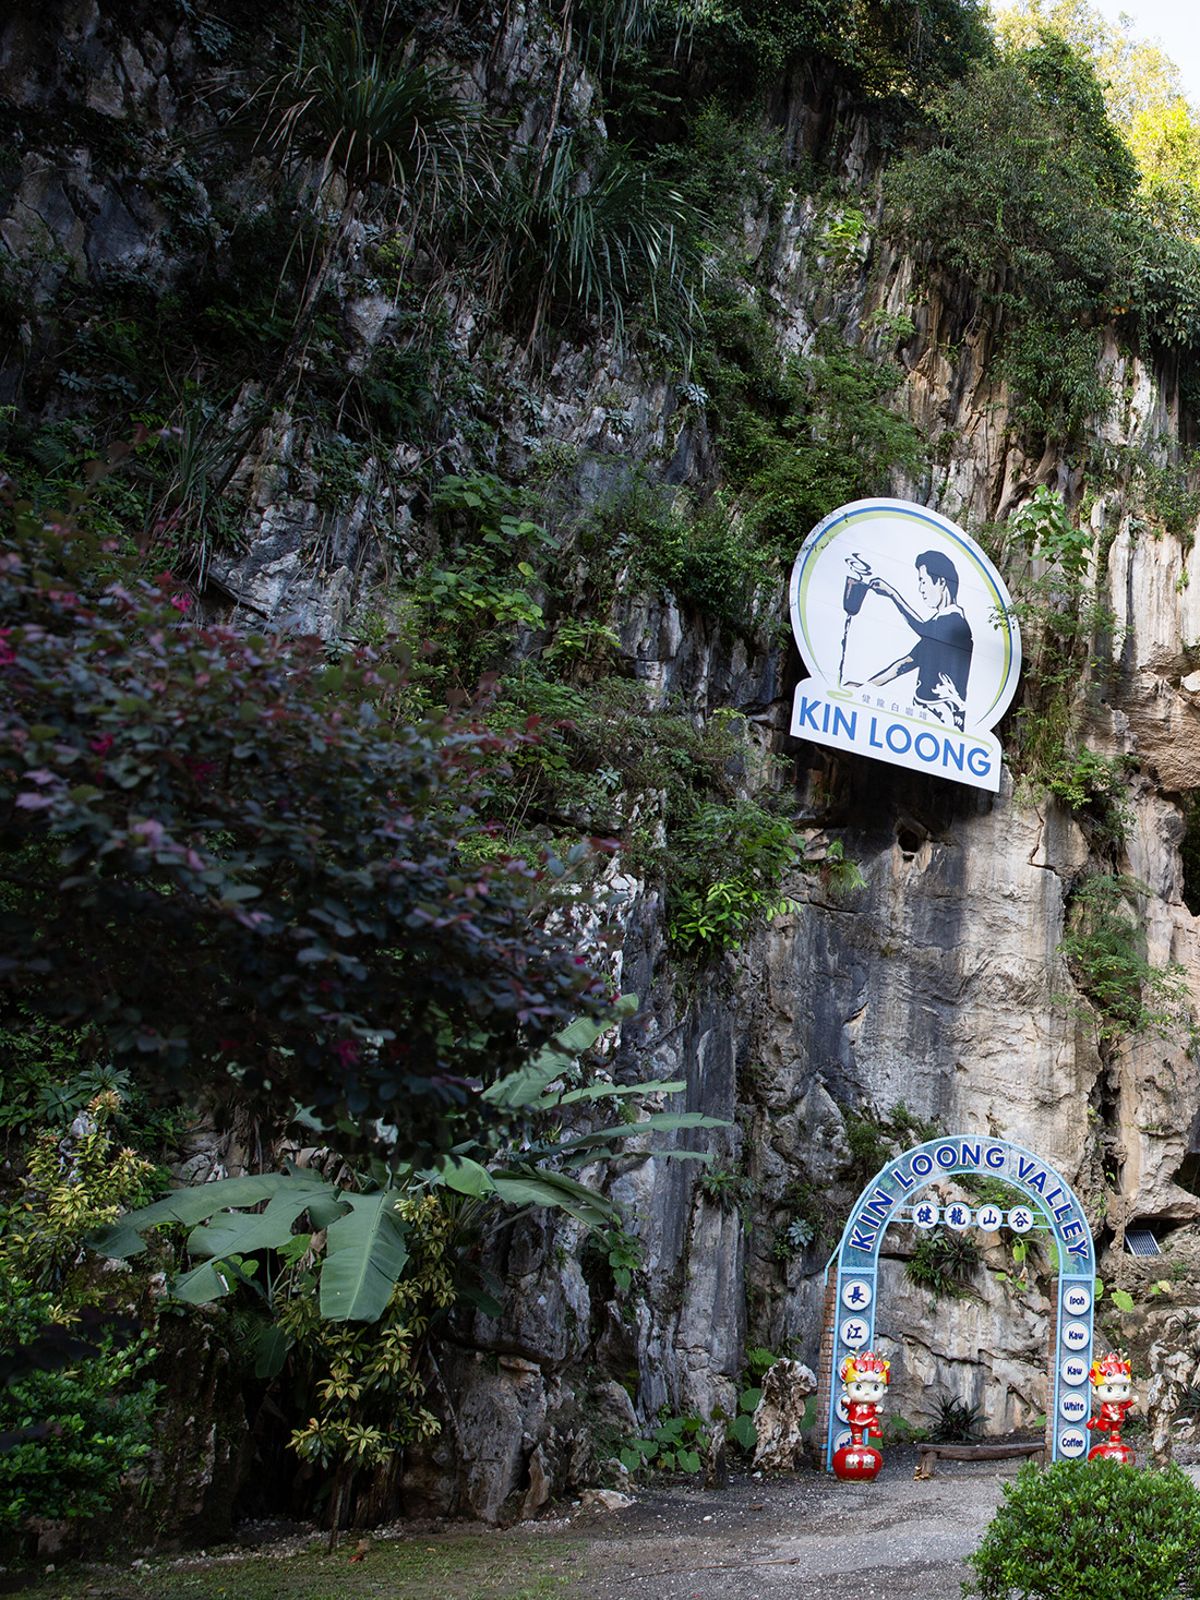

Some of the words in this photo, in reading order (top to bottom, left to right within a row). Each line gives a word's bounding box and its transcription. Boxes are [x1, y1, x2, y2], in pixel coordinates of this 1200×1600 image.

[799, 696, 857, 740] KIN
[869, 716, 991, 777] LOONG
[849, 1188, 894, 1252] KIN
[892, 1143, 1005, 1190] LOONG
[1016, 1156, 1089, 1260] VALLEY
[916, 1205, 1029, 1228] 健龍山谷
[1069, 1296, 1085, 1305] Ipoh
[1068, 1331, 1084, 1340] Kaw
[1067, 1366, 1082, 1375] Kaw
[1063, 1402, 1084, 1411] White
[1061, 1438, 1083, 1447] Coffee
